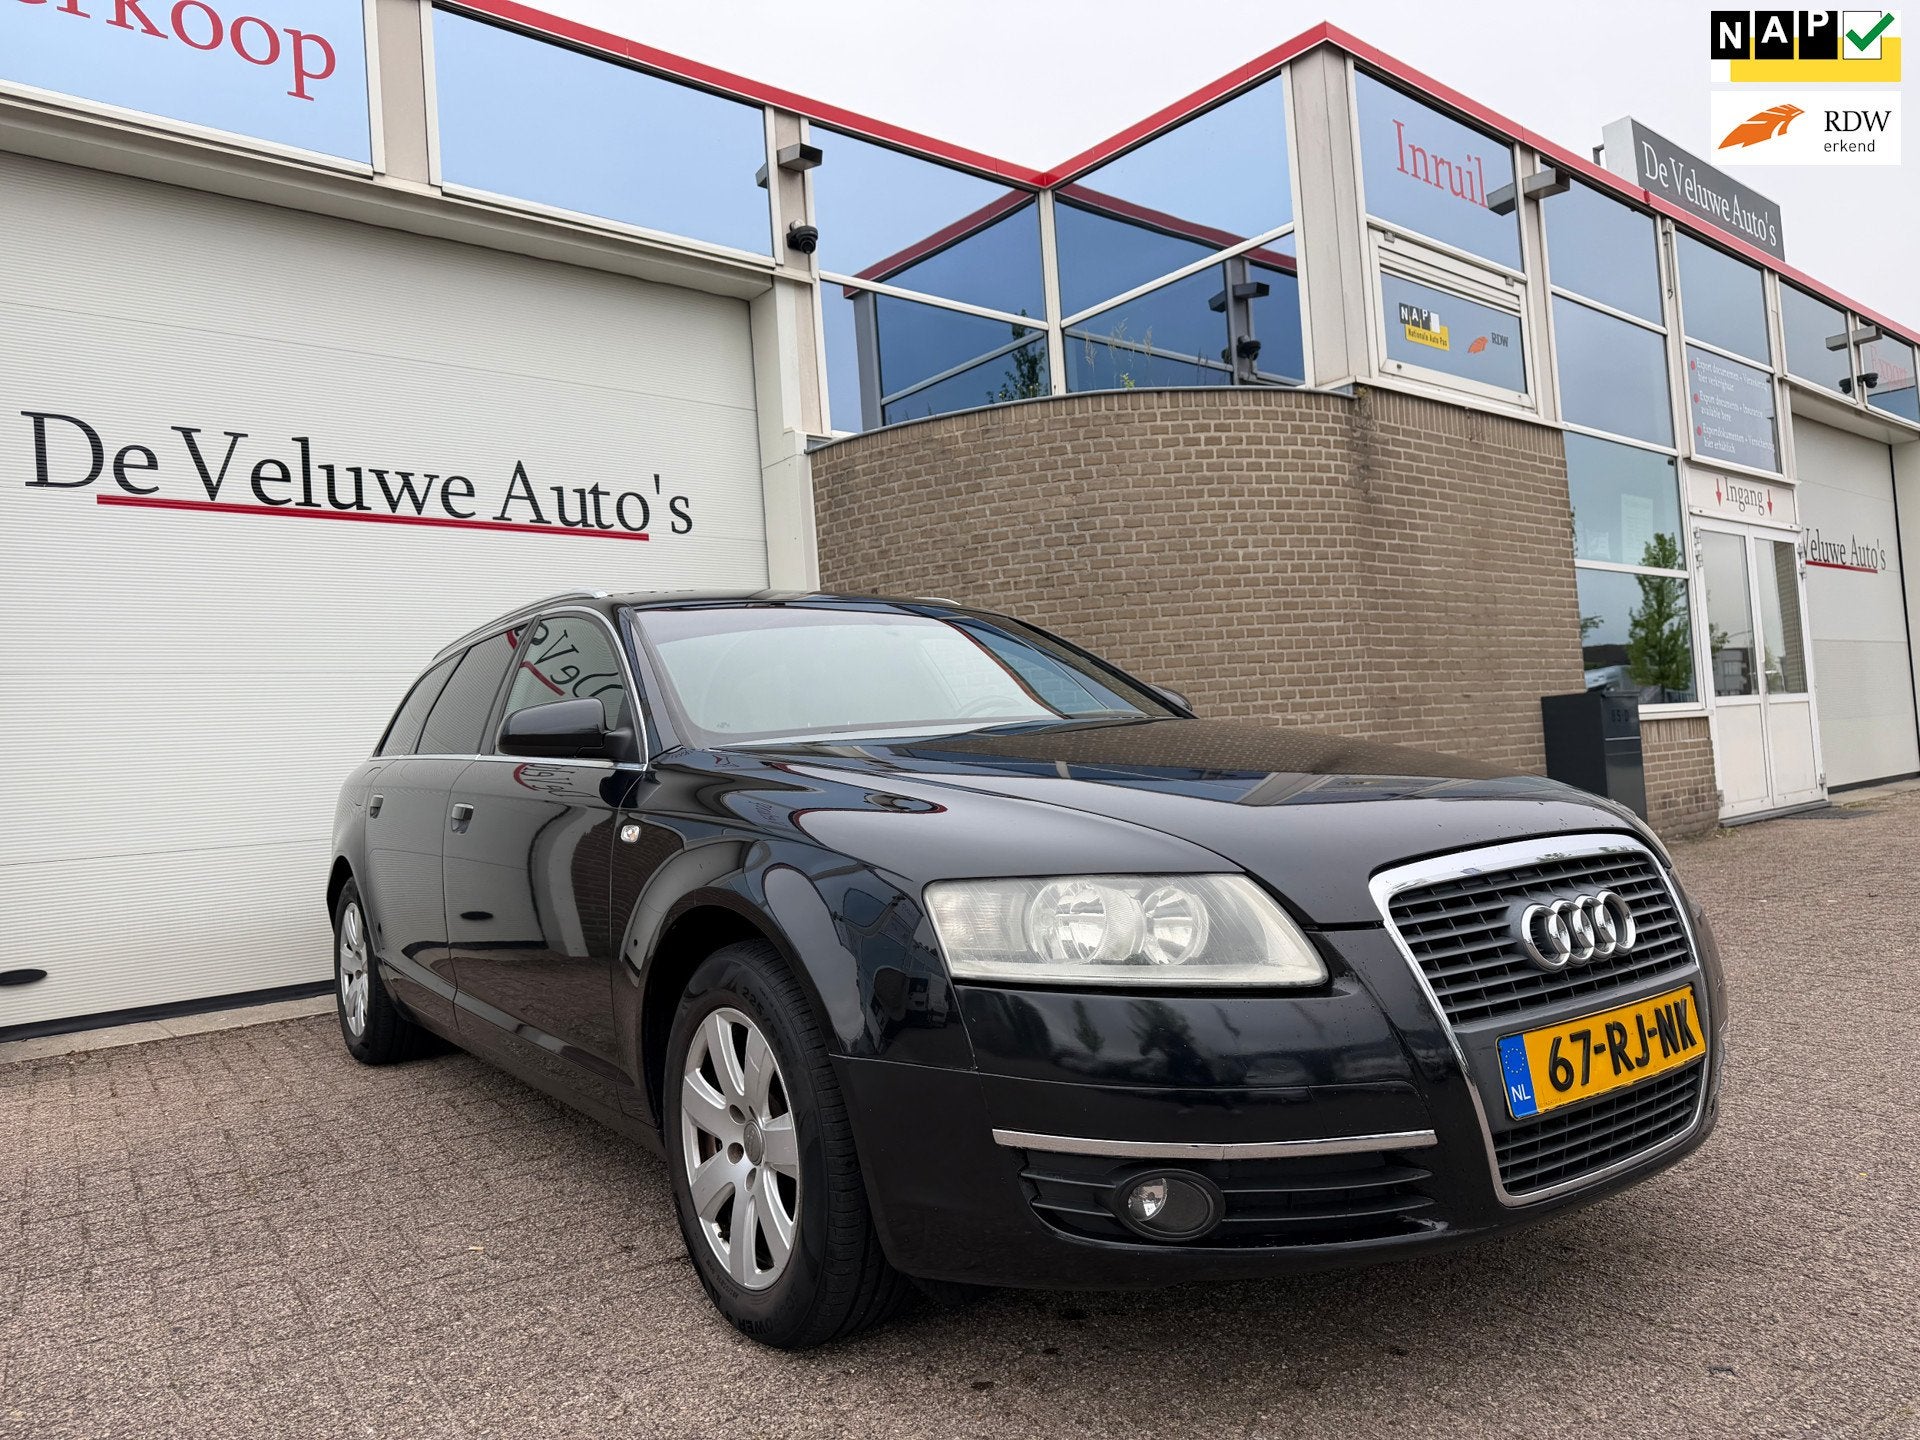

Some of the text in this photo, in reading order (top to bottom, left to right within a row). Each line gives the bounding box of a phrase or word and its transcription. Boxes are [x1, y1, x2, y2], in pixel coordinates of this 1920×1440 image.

[17, 0, 336, 101] oop
[1392, 118, 1489, 208] Inruil
[1641, 140, 1777, 247] De Veluwe Auto's
[1401, 306, 1429, 321] NAP
[1491, 332, 1509, 347] RDW
[20, 411, 694, 535] De Veluwe Auto's
[1724, 477, 1765, 516] Ingang
[1850, 534, 1886, 570] Auto's
[1549, 998, 1697, 1093] 67-RJ-NK
[1511, 1083, 1531, 1103] NL
